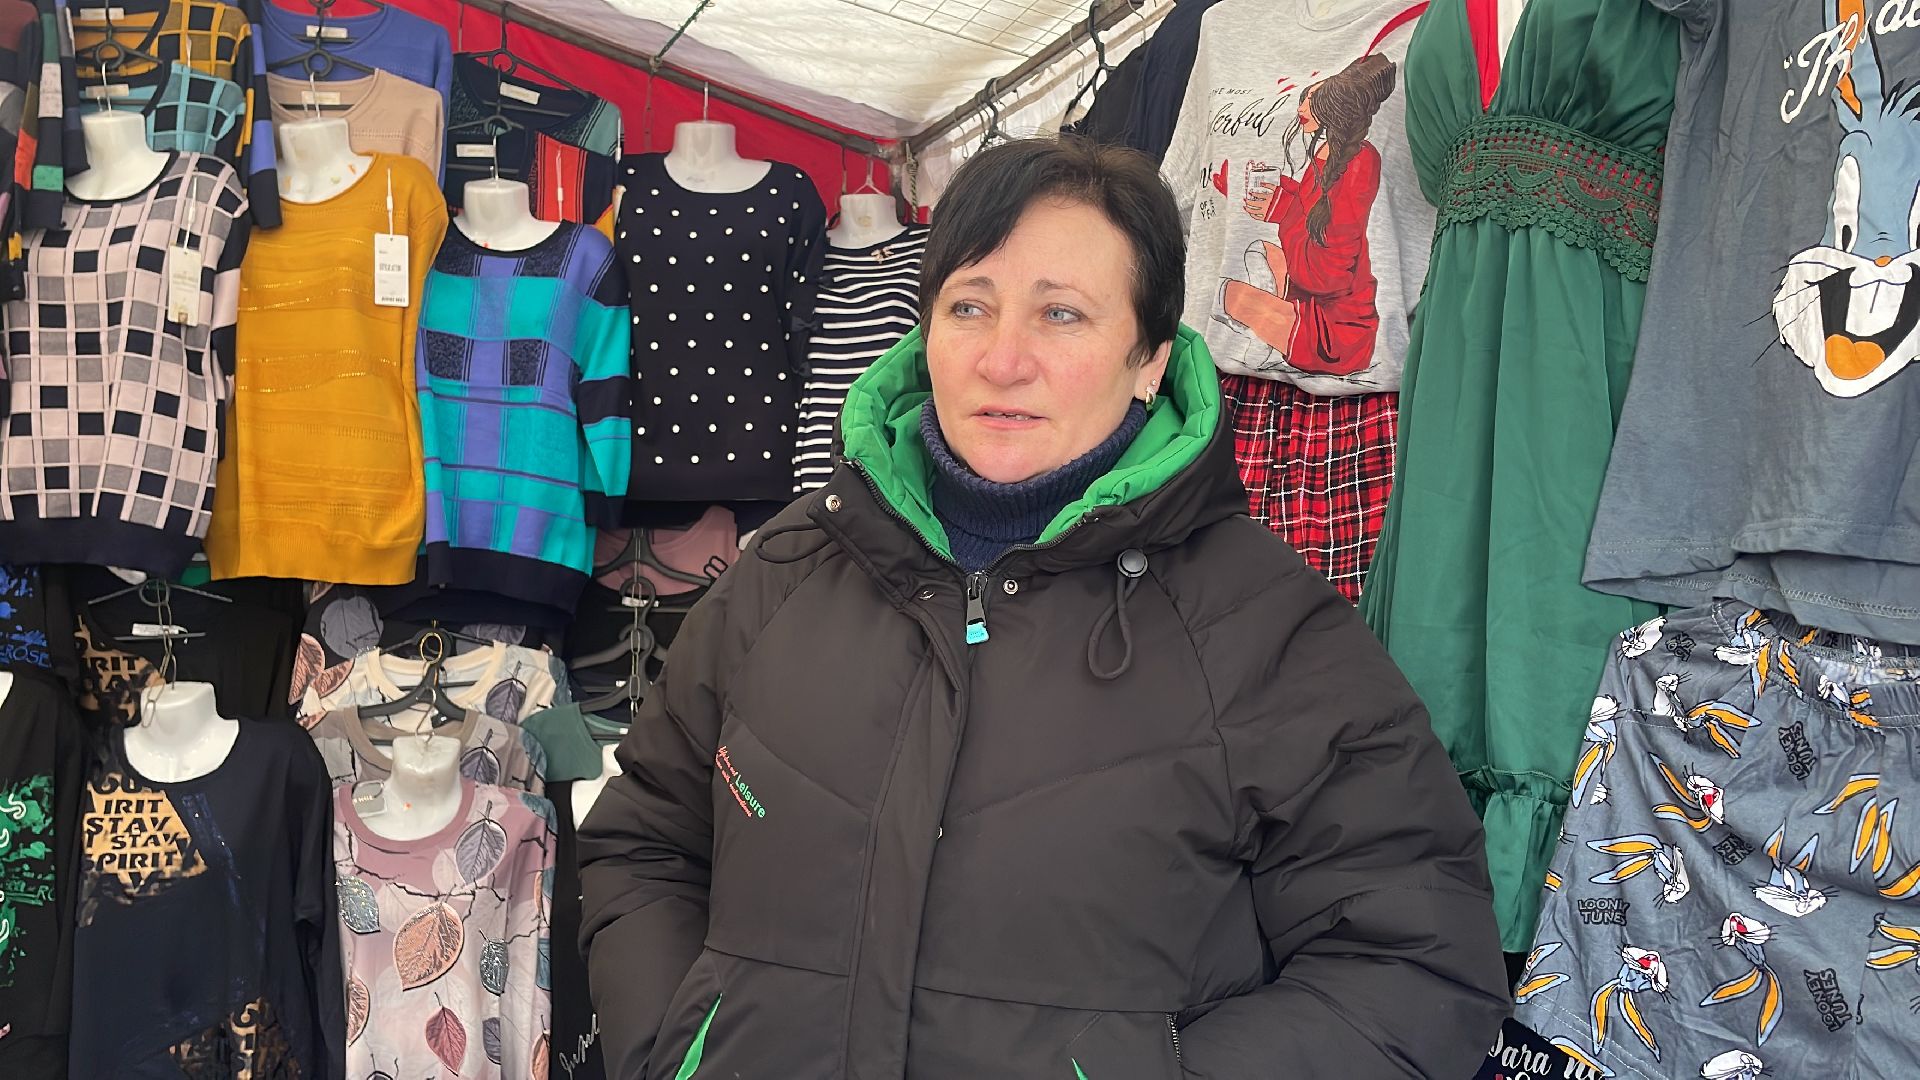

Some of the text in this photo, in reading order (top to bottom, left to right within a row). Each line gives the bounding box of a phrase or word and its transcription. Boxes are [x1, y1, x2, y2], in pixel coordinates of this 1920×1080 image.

[735, 773, 767, 818] Leisure
[1803, 968, 1841, 1032] LOONEY
[1819, 967, 1853, 1025] TUNES
